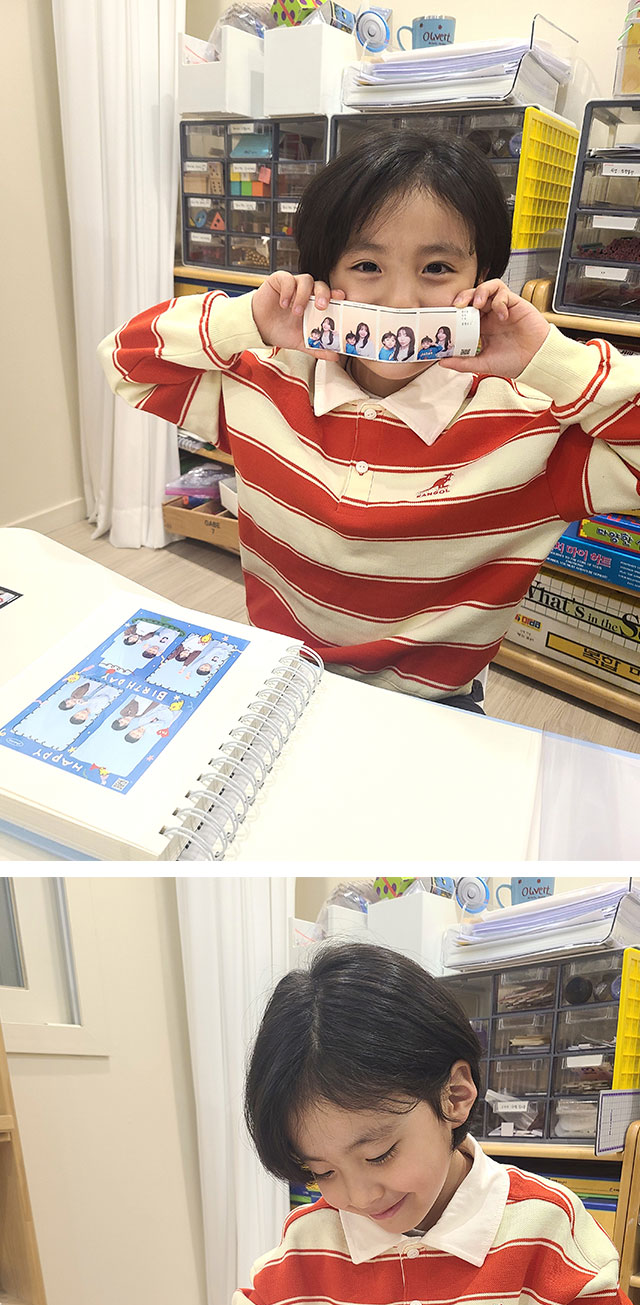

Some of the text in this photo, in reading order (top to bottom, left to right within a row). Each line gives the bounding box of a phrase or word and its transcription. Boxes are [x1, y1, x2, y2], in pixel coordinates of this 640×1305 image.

[588, 613, 598, 624] in
[601, 617, 618, 632] the
[32, 748, 84, 773] HAPPY
